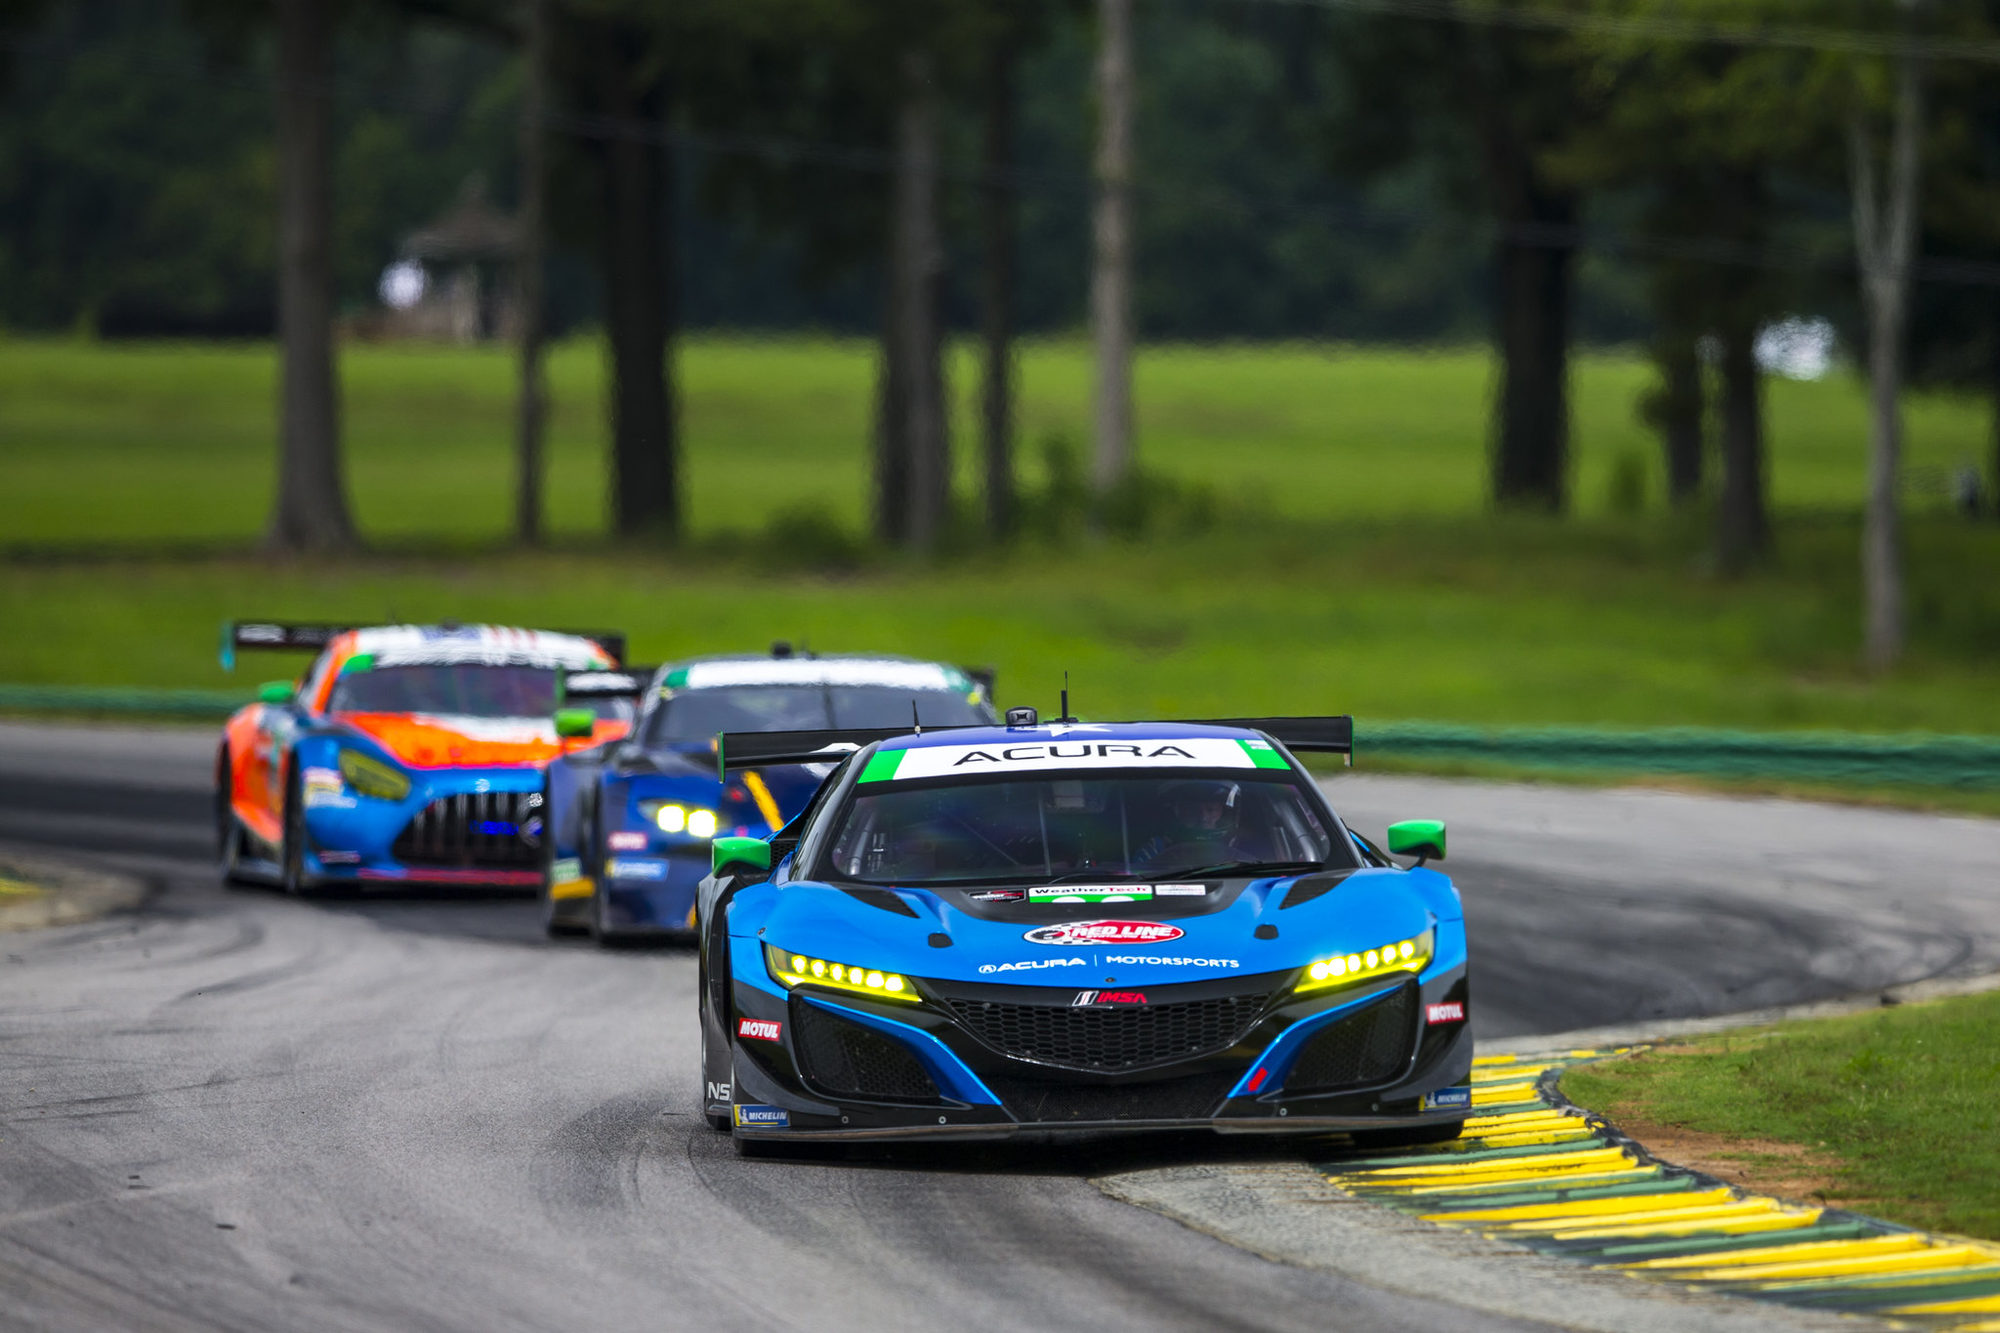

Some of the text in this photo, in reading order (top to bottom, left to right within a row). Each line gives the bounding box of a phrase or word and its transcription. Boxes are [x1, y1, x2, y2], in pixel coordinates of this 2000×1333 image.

[953, 742, 1197, 767] ACURA
[1035, 886, 1147, 895] WeatherTech
[1071, 926, 1118, 937] RED
[1121, 926, 1173, 937] LINE
[997, 955, 1240, 971] ACURA MOTORSPORTS
[1096, 991, 1148, 1004] IMSA
[1429, 1004, 1463, 1021] MOTUL
[740, 1021, 779, 1039] MOTUL
[708, 1081, 732, 1101] NS
[748, 1111, 787, 1122] MICHELIN
